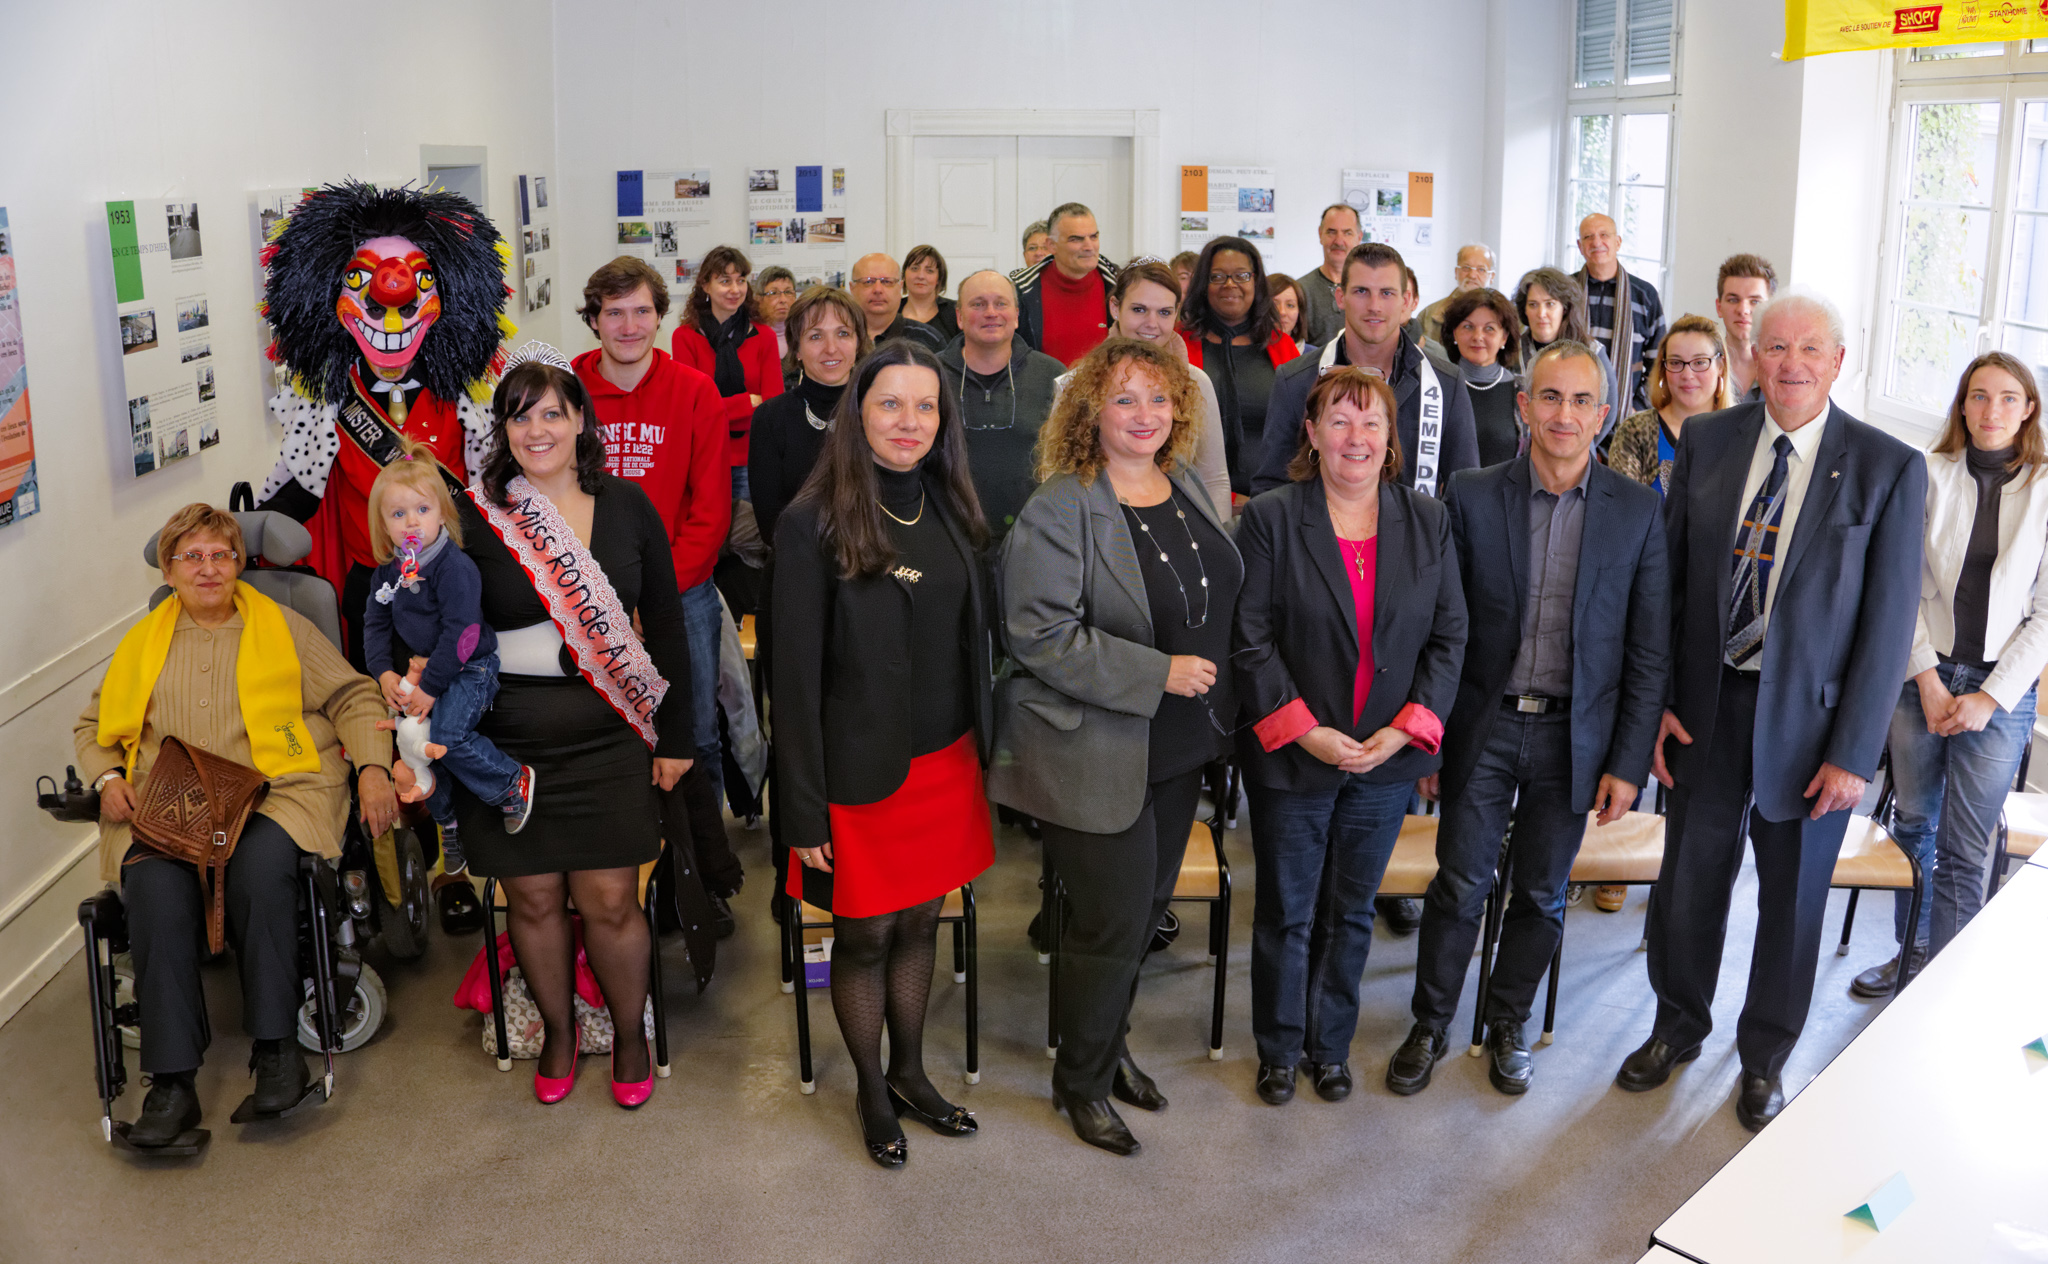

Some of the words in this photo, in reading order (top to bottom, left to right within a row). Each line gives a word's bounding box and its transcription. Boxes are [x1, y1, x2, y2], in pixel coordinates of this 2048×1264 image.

[1989, 7, 2028, 18] STANHOME
[1840, 25, 1852, 33] AVEC
[1853, 24, 1860, 32] LE
[1861, 21, 1881, 31] SOUTIEN
[619, 174, 639, 182] 2013
[798, 169, 818, 177] 2013
[1183, 169, 1203, 177] 2103
[110, 210, 131, 225] 1953
[112, 248, 121, 258] EN
[121, 247, 129, 256] CE
[130, 243, 149, 255] TEMPS
[342, 399, 384, 449] MISTER
[1420, 386, 1439, 455] 4EME
[605, 443, 631, 455] SINE
